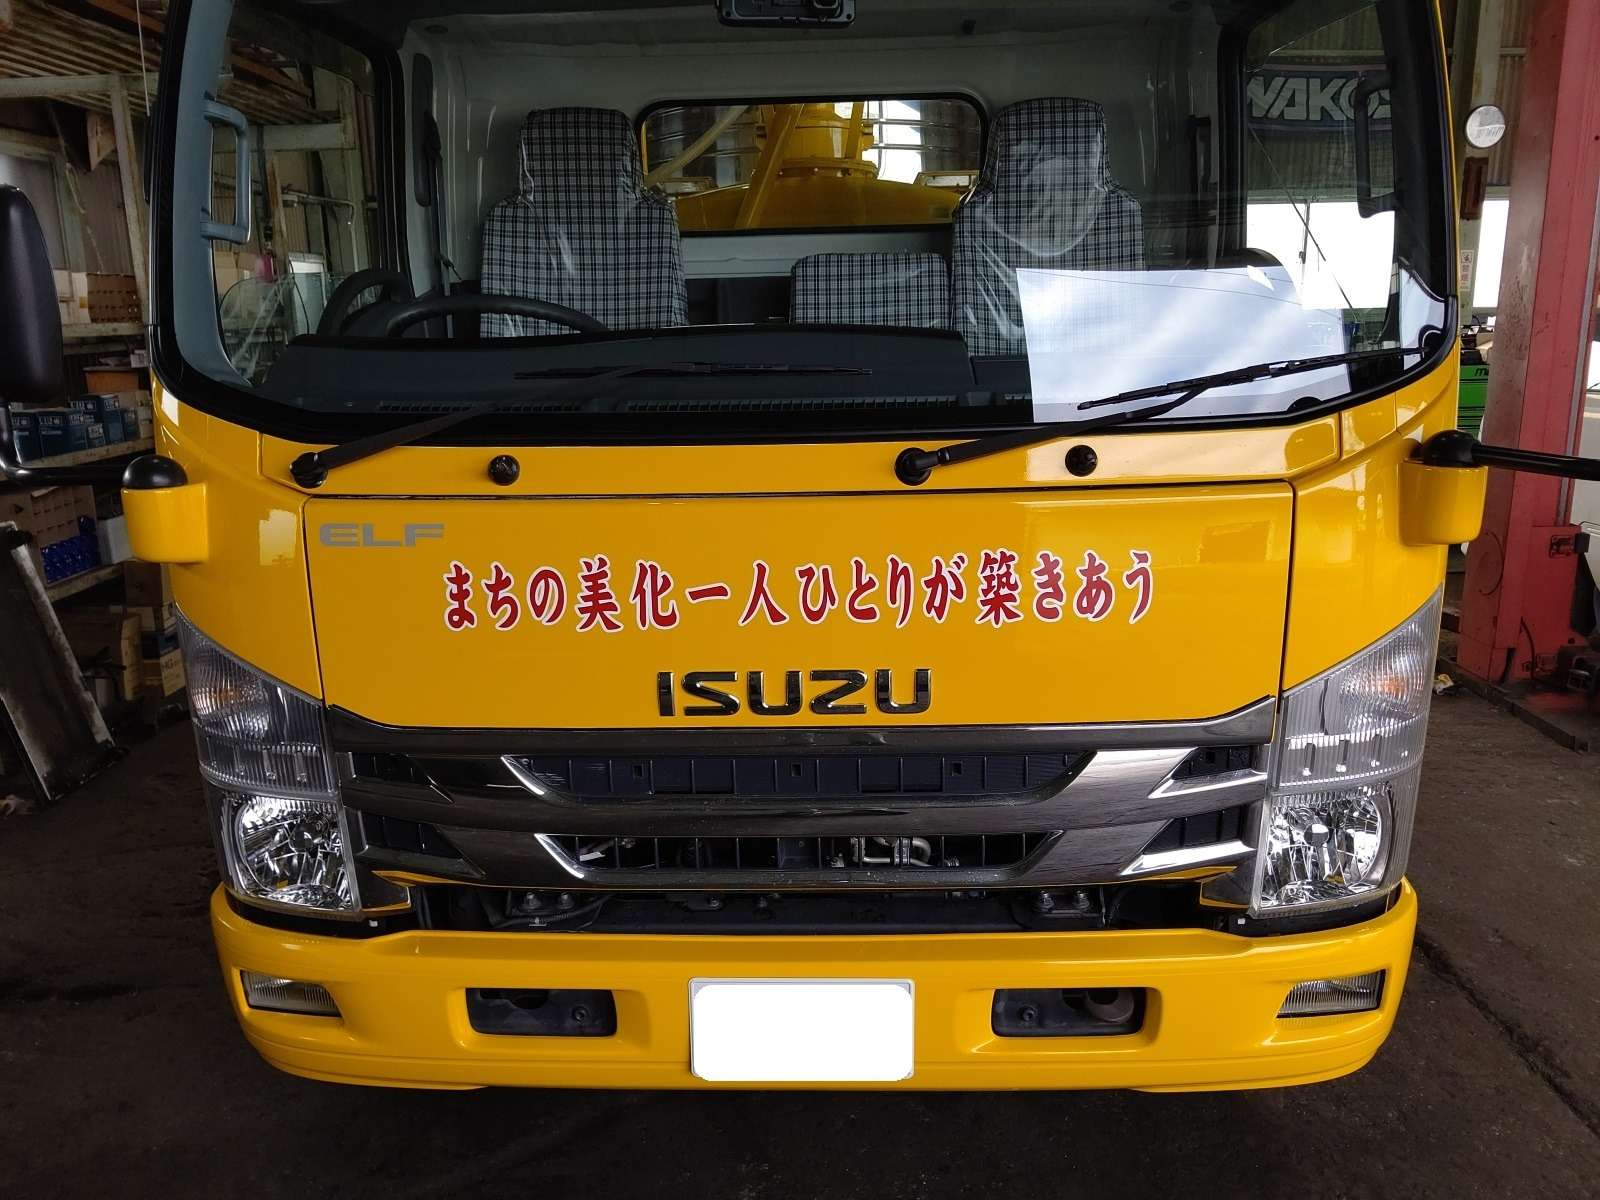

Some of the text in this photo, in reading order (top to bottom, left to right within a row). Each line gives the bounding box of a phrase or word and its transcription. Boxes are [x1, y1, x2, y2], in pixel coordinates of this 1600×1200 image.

[319, 523, 445, 547] ELF
[443, 548, 1153, 633] まちの美化一人ひとりが築きあう
[657, 668, 932, 717] ISUZU
